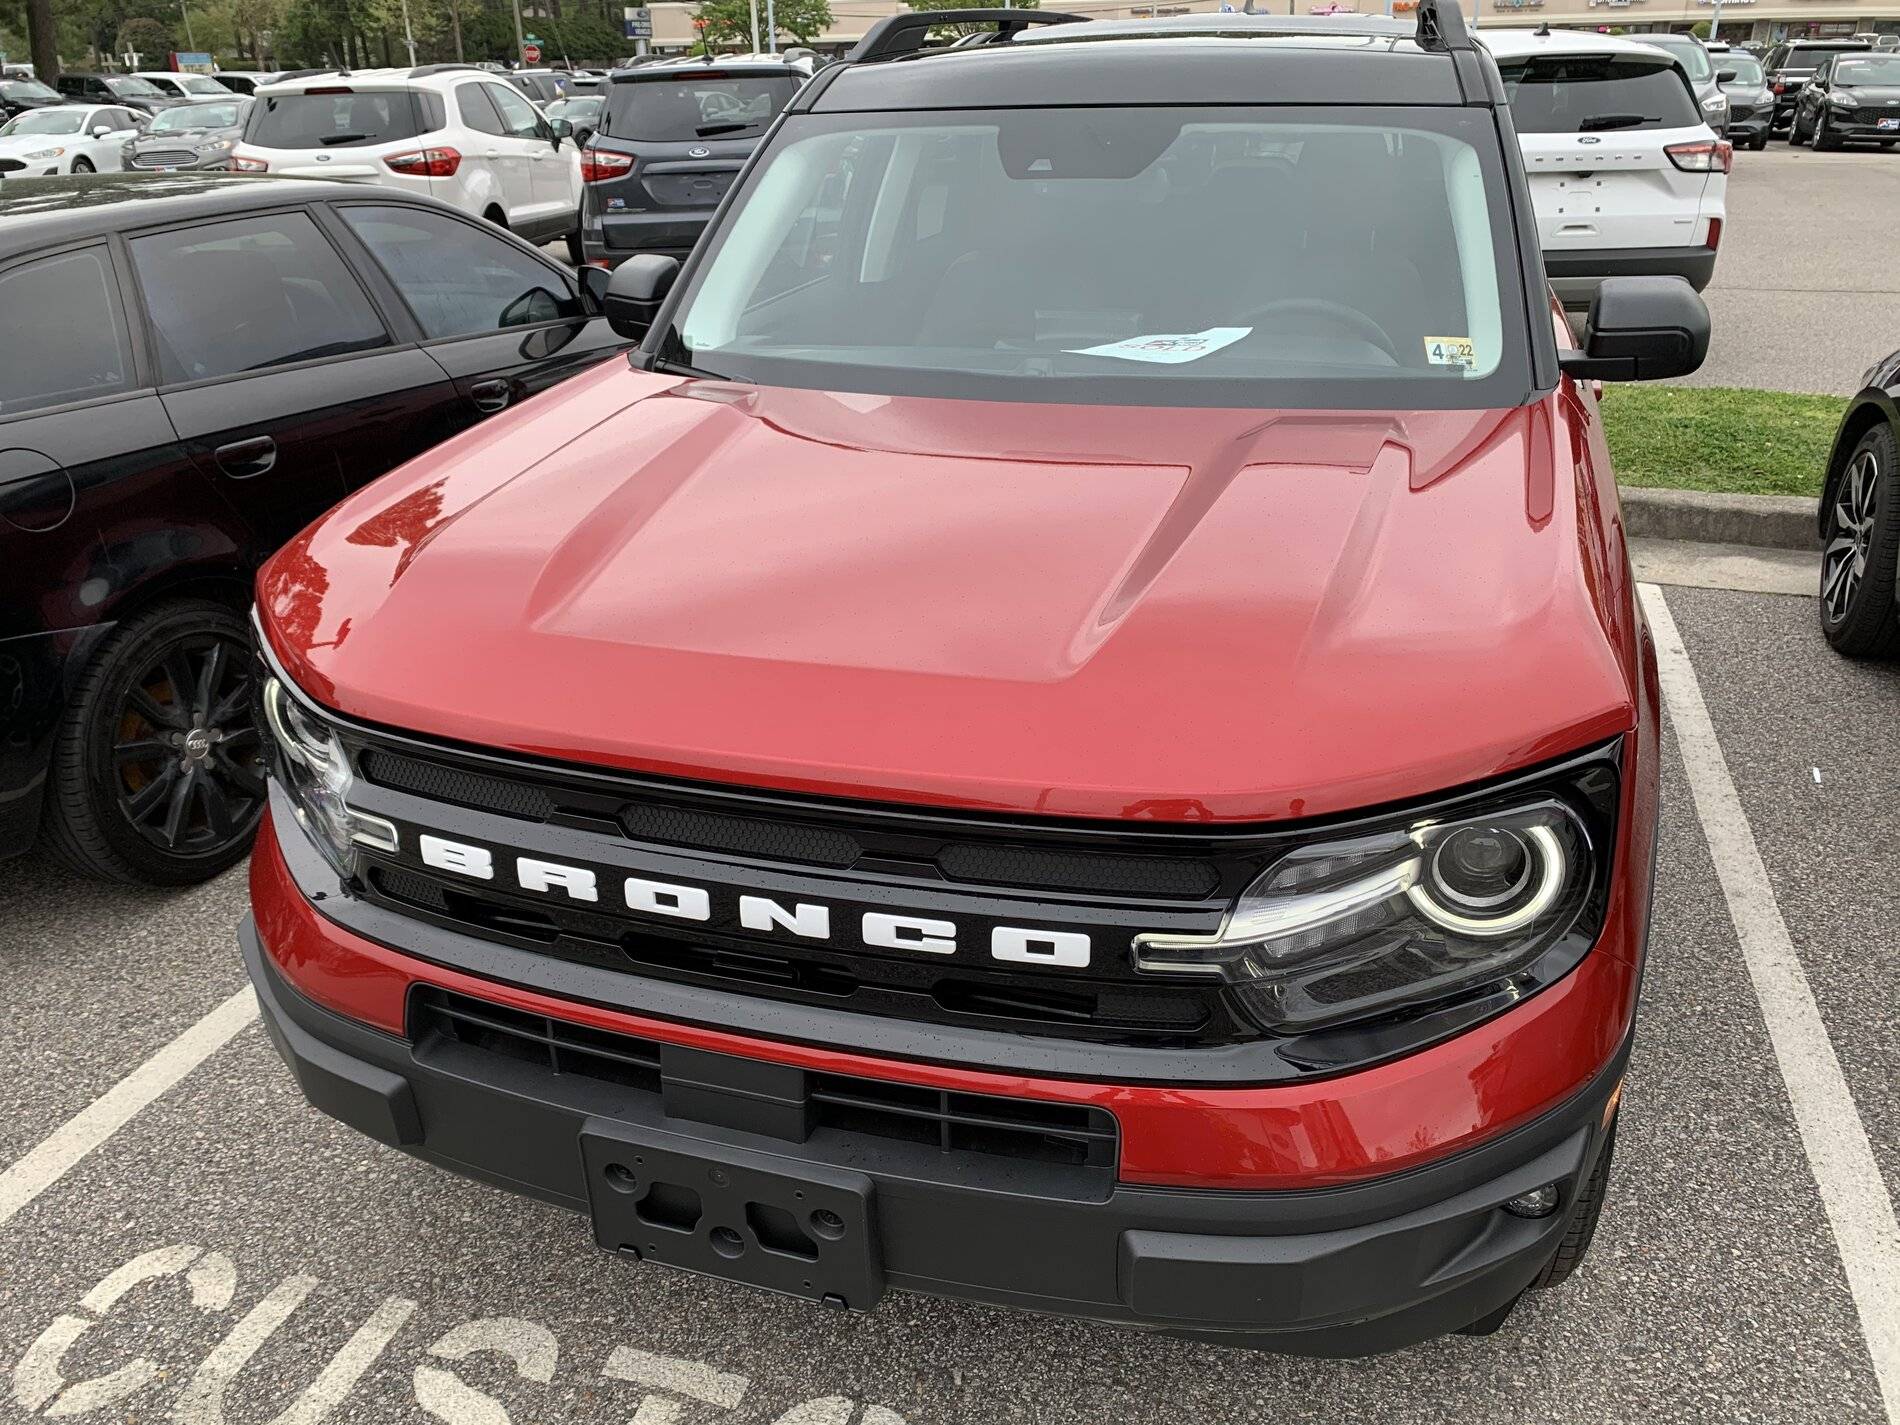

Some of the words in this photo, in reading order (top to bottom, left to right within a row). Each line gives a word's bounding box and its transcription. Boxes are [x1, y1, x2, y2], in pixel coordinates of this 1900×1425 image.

[1432, 344, 1445, 360] 4
[1458, 344, 1474, 357] 22
[418, 833, 1092, 969] BRONCO
